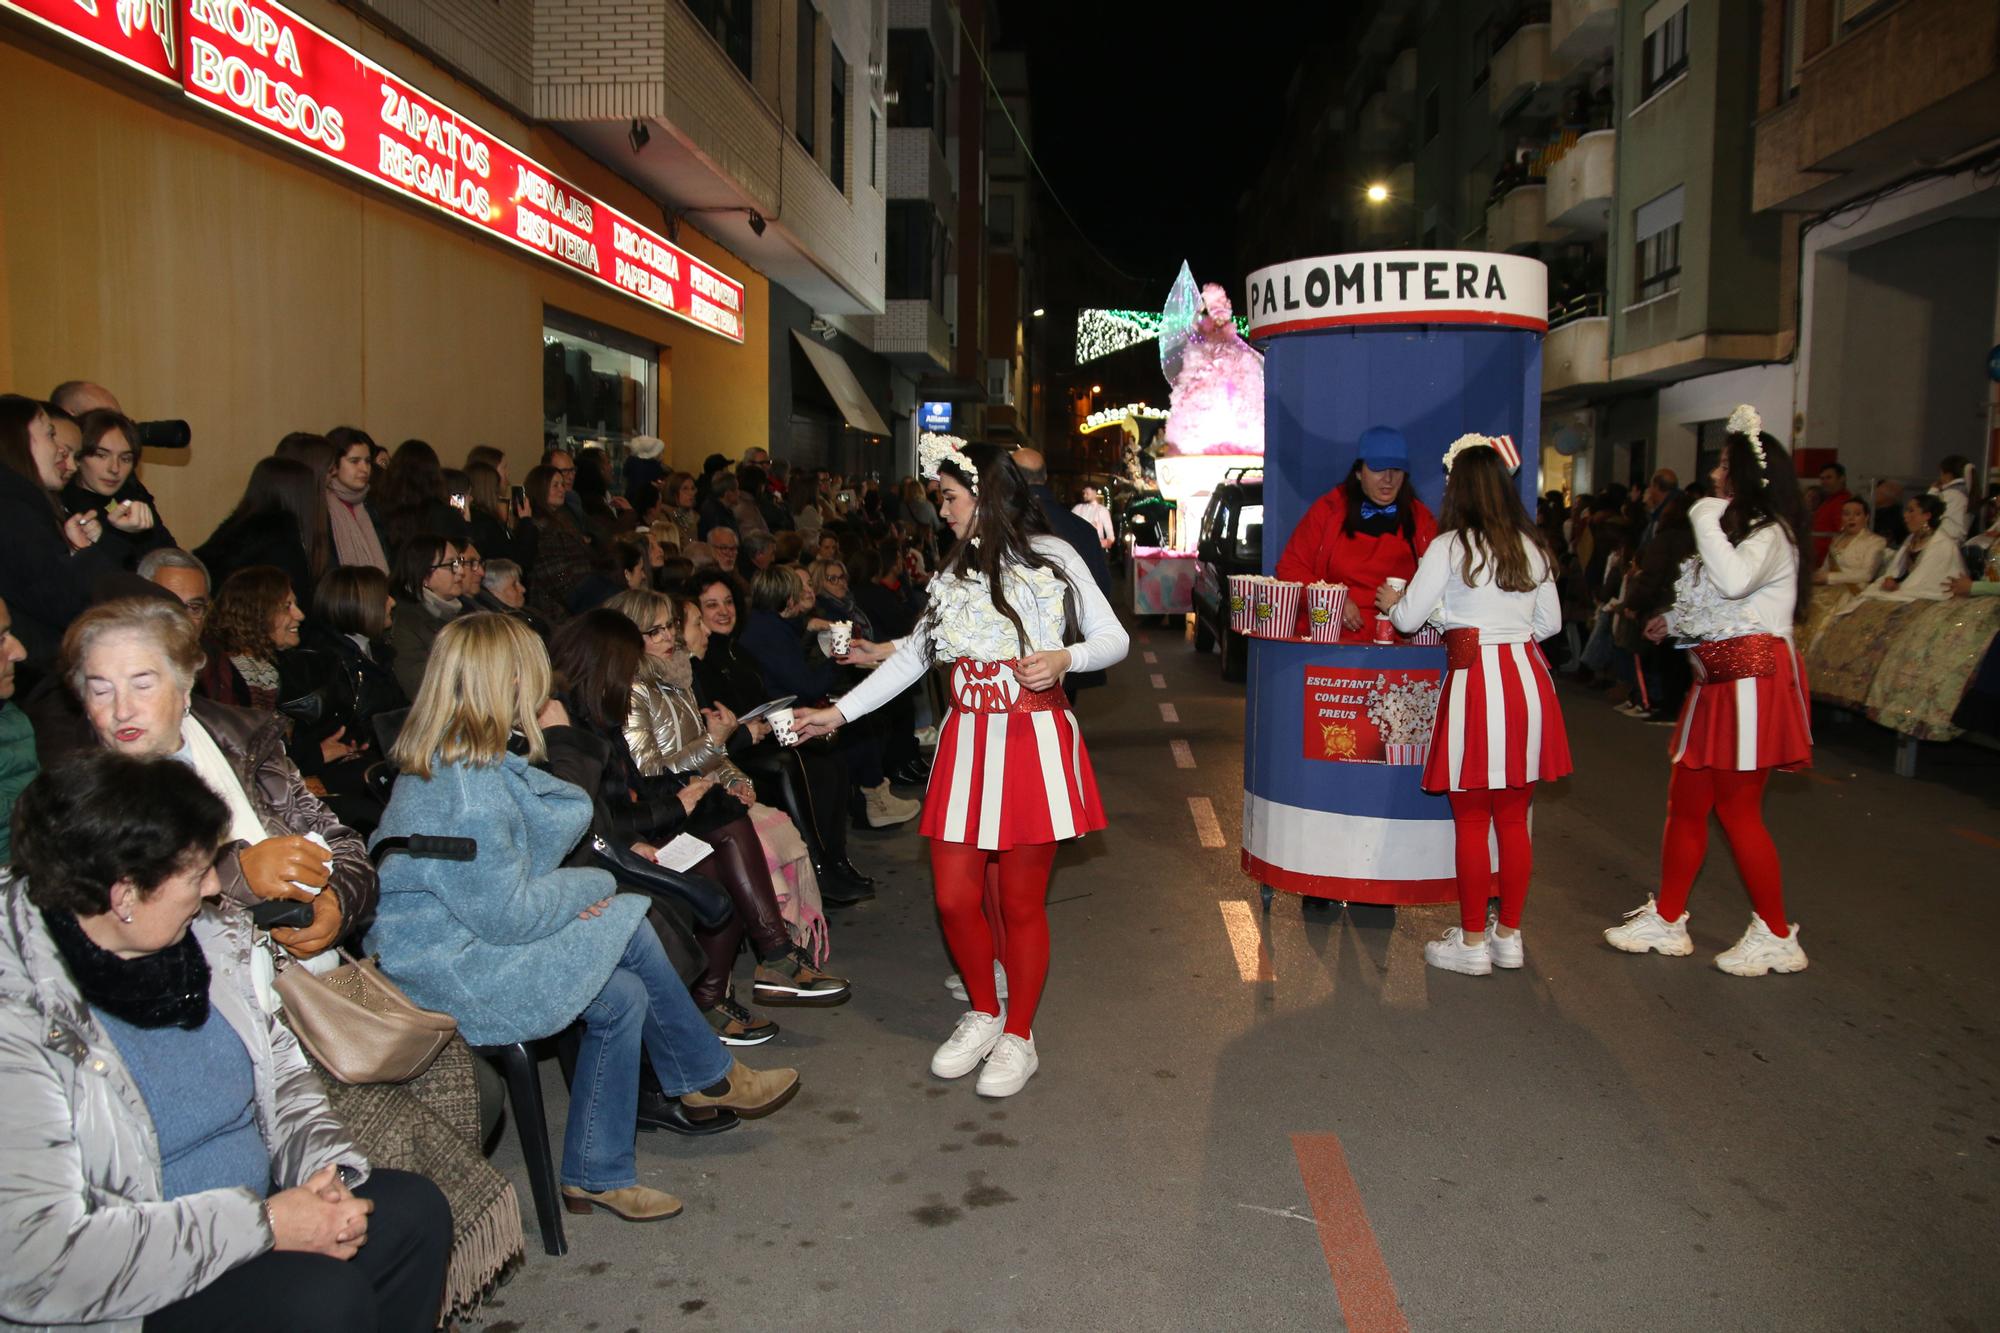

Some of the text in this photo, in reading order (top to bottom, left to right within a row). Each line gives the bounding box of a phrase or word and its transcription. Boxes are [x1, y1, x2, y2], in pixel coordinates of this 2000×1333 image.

[190, 36, 345, 151] BOLSOS
[380, 83, 490, 179] ZAPATOS
[379, 133, 490, 222] REGALOS
[516, 164, 594, 234] MENAJES
[516, 205, 600, 273] BISUTERIA
[613, 221, 680, 281] DROGUERIA
[615, 256, 675, 309] PAPELERIA
[1250, 261, 1507, 319] PALOMITERA
[925, 414, 950, 423] Allianz
[959, 656, 1000, 682] POP
[1306, 676, 1375, 690] ESCLATANT
[959, 680, 1013, 714] CORN
[1314, 692, 1364, 705] COM ELS
[1318, 708, 1357, 720] PREUS
